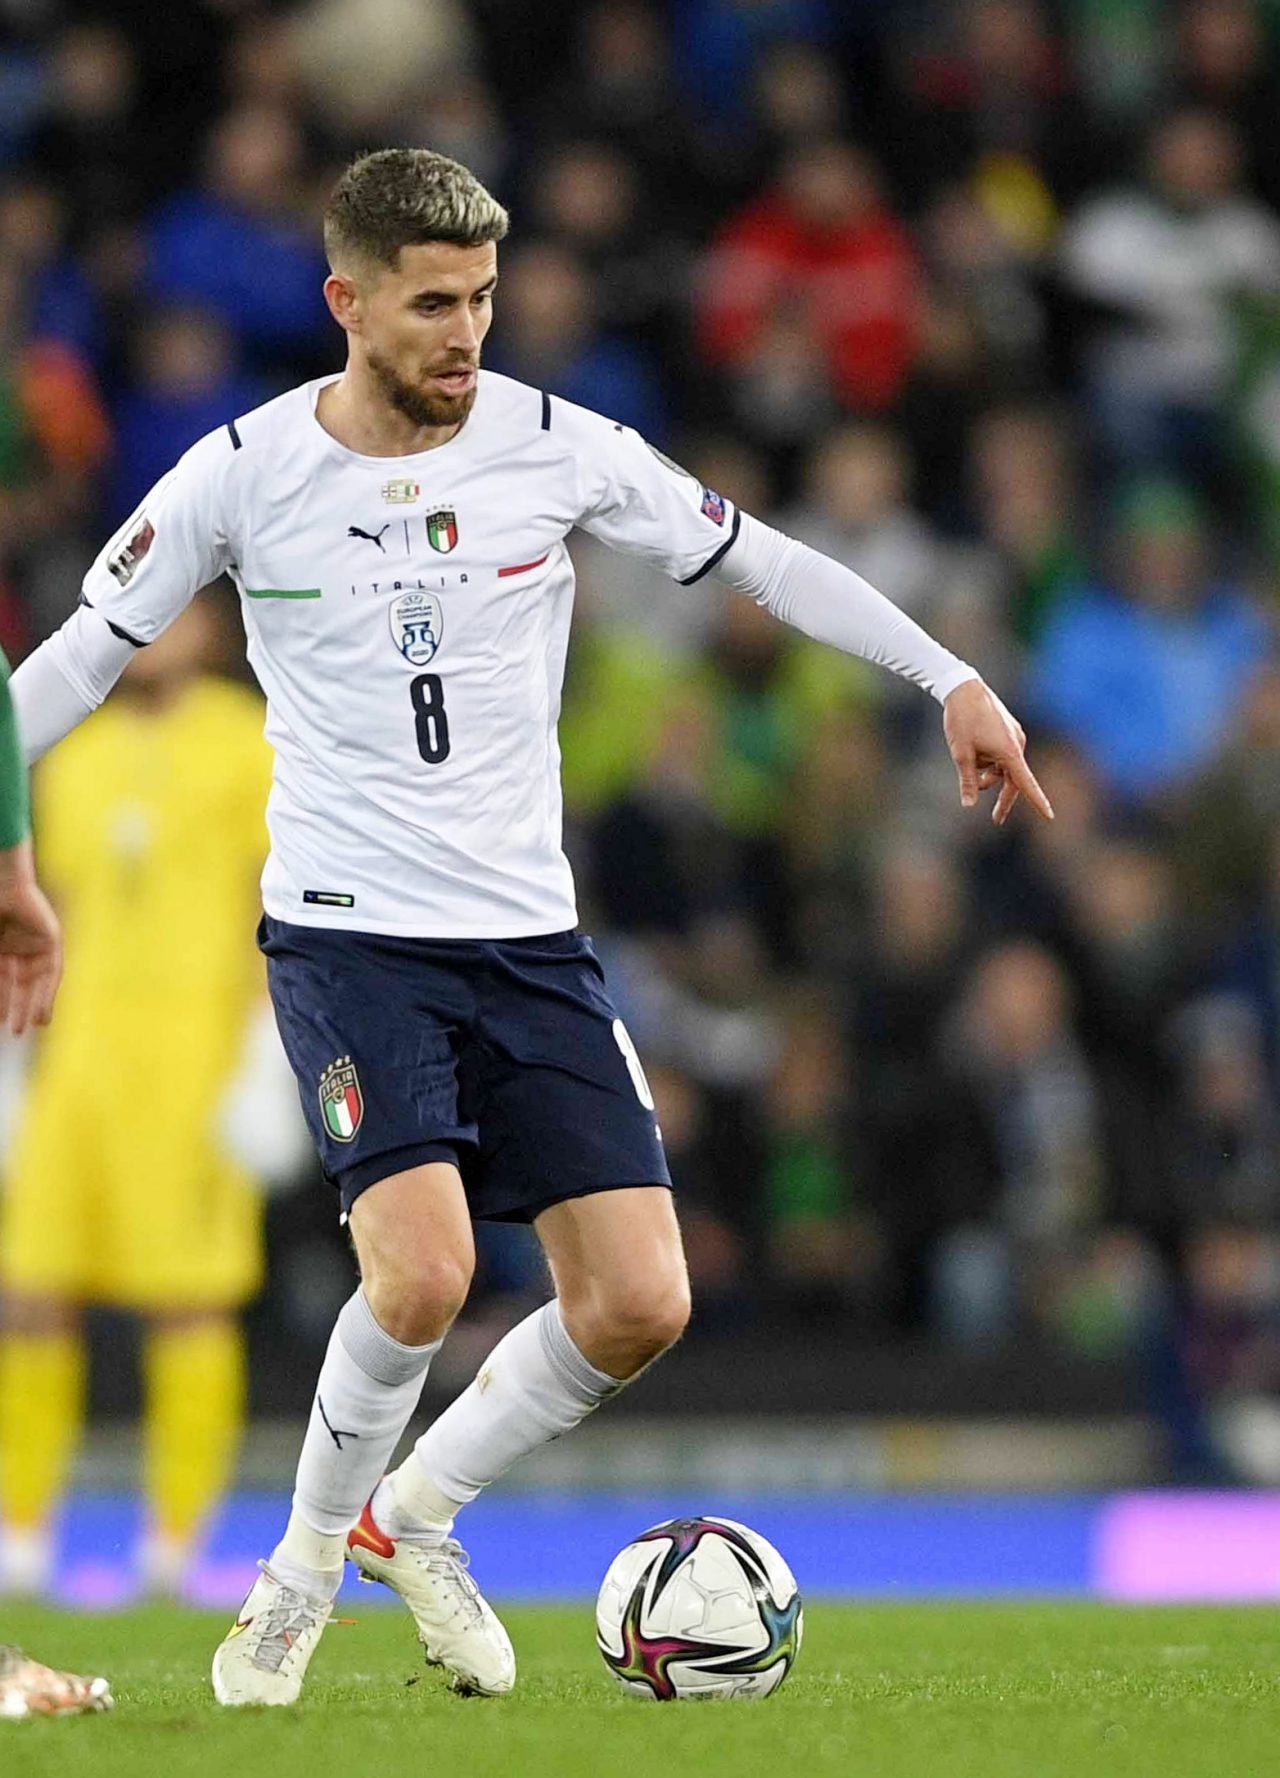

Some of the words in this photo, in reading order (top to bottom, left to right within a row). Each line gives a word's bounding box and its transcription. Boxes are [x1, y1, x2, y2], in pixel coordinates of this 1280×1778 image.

[351, 573, 468, 596] ITALIA
[410, 673, 451, 765] 8
[322, 1071, 353, 1097] ITALIA
